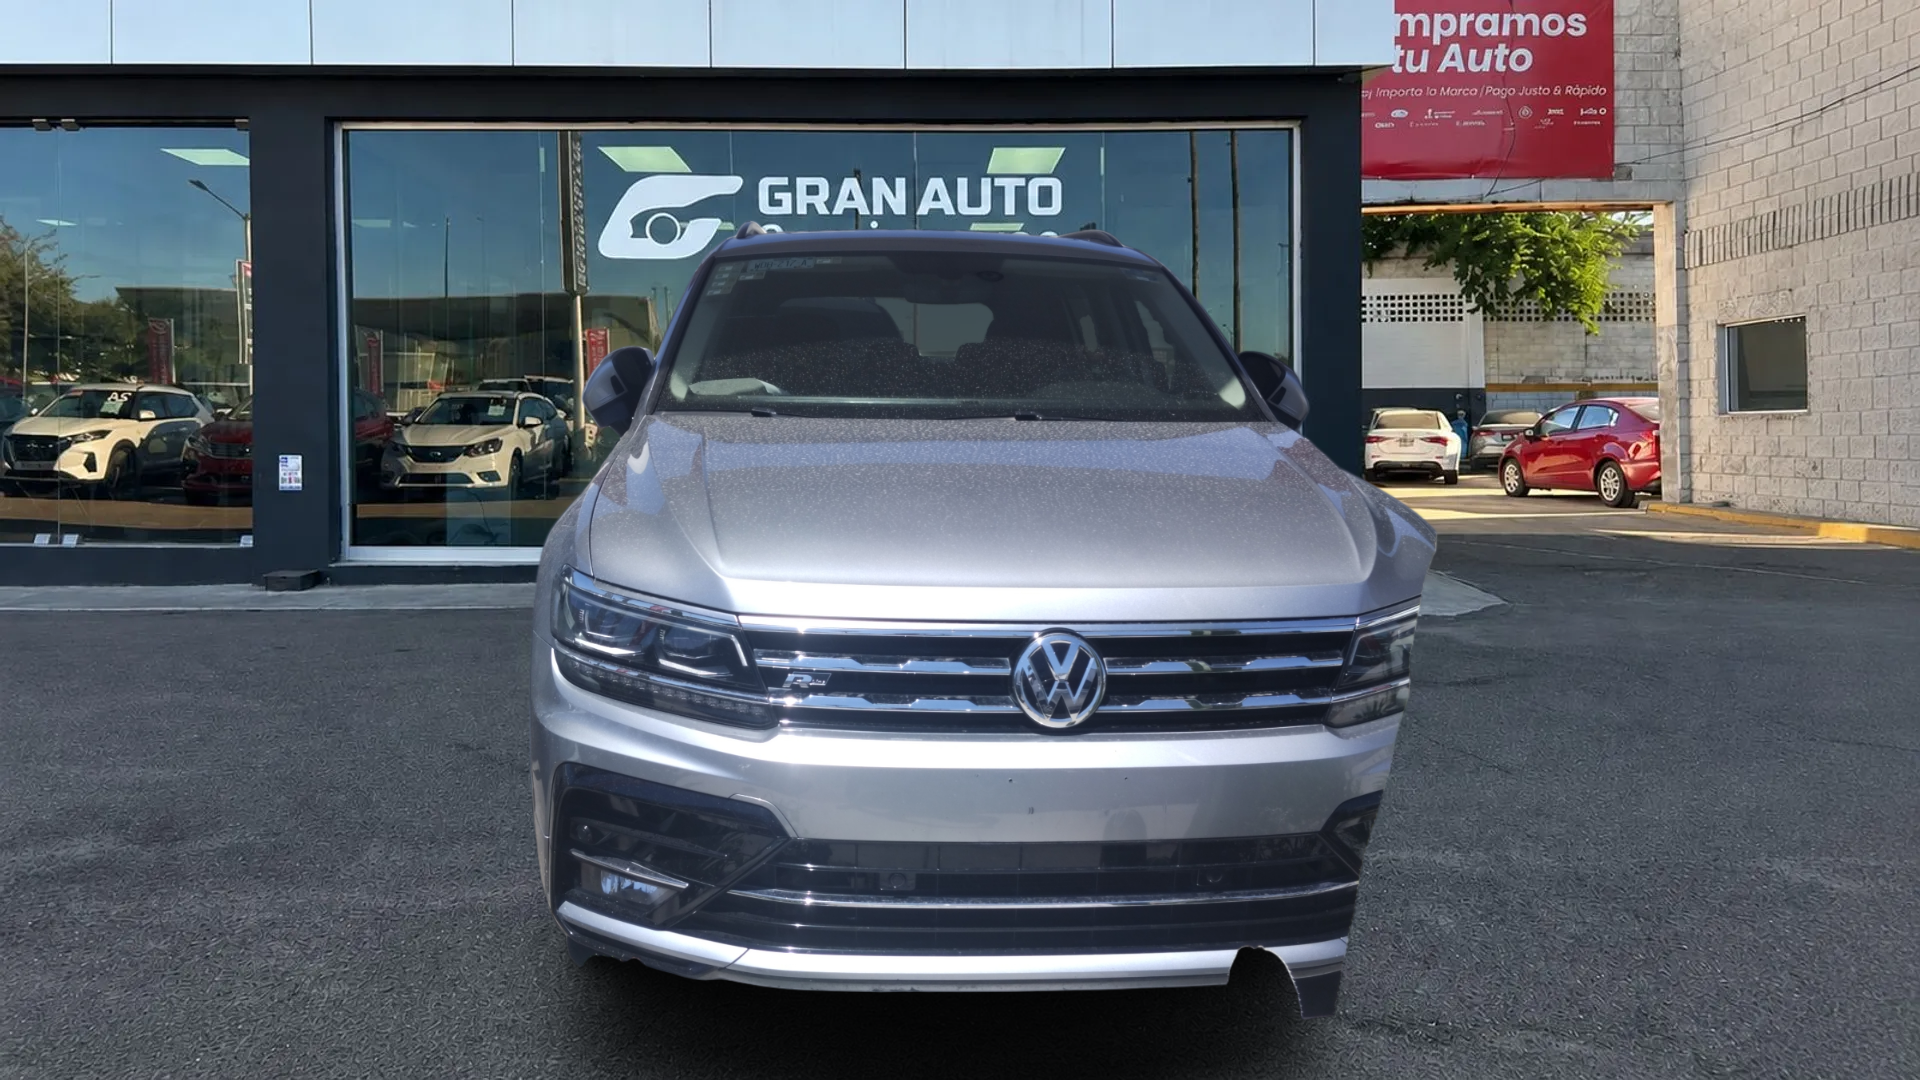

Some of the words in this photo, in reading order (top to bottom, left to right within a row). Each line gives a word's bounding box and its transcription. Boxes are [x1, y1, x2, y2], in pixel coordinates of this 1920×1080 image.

[1392, 44, 1430, 73] tu
[1437, 43, 1533, 73] Auto
[1376, 87, 1423, 99] Importa
[1426, 86, 1437, 97] la
[1440, 86, 1478, 97] Marca
[1519, 86, 1551, 96] Justo
[1564, 84, 1607, 99] Rápido
[758, 177, 906, 216] GRAN
[916, 177, 1062, 216] AUTO
[782, 673, 813, 689] R
